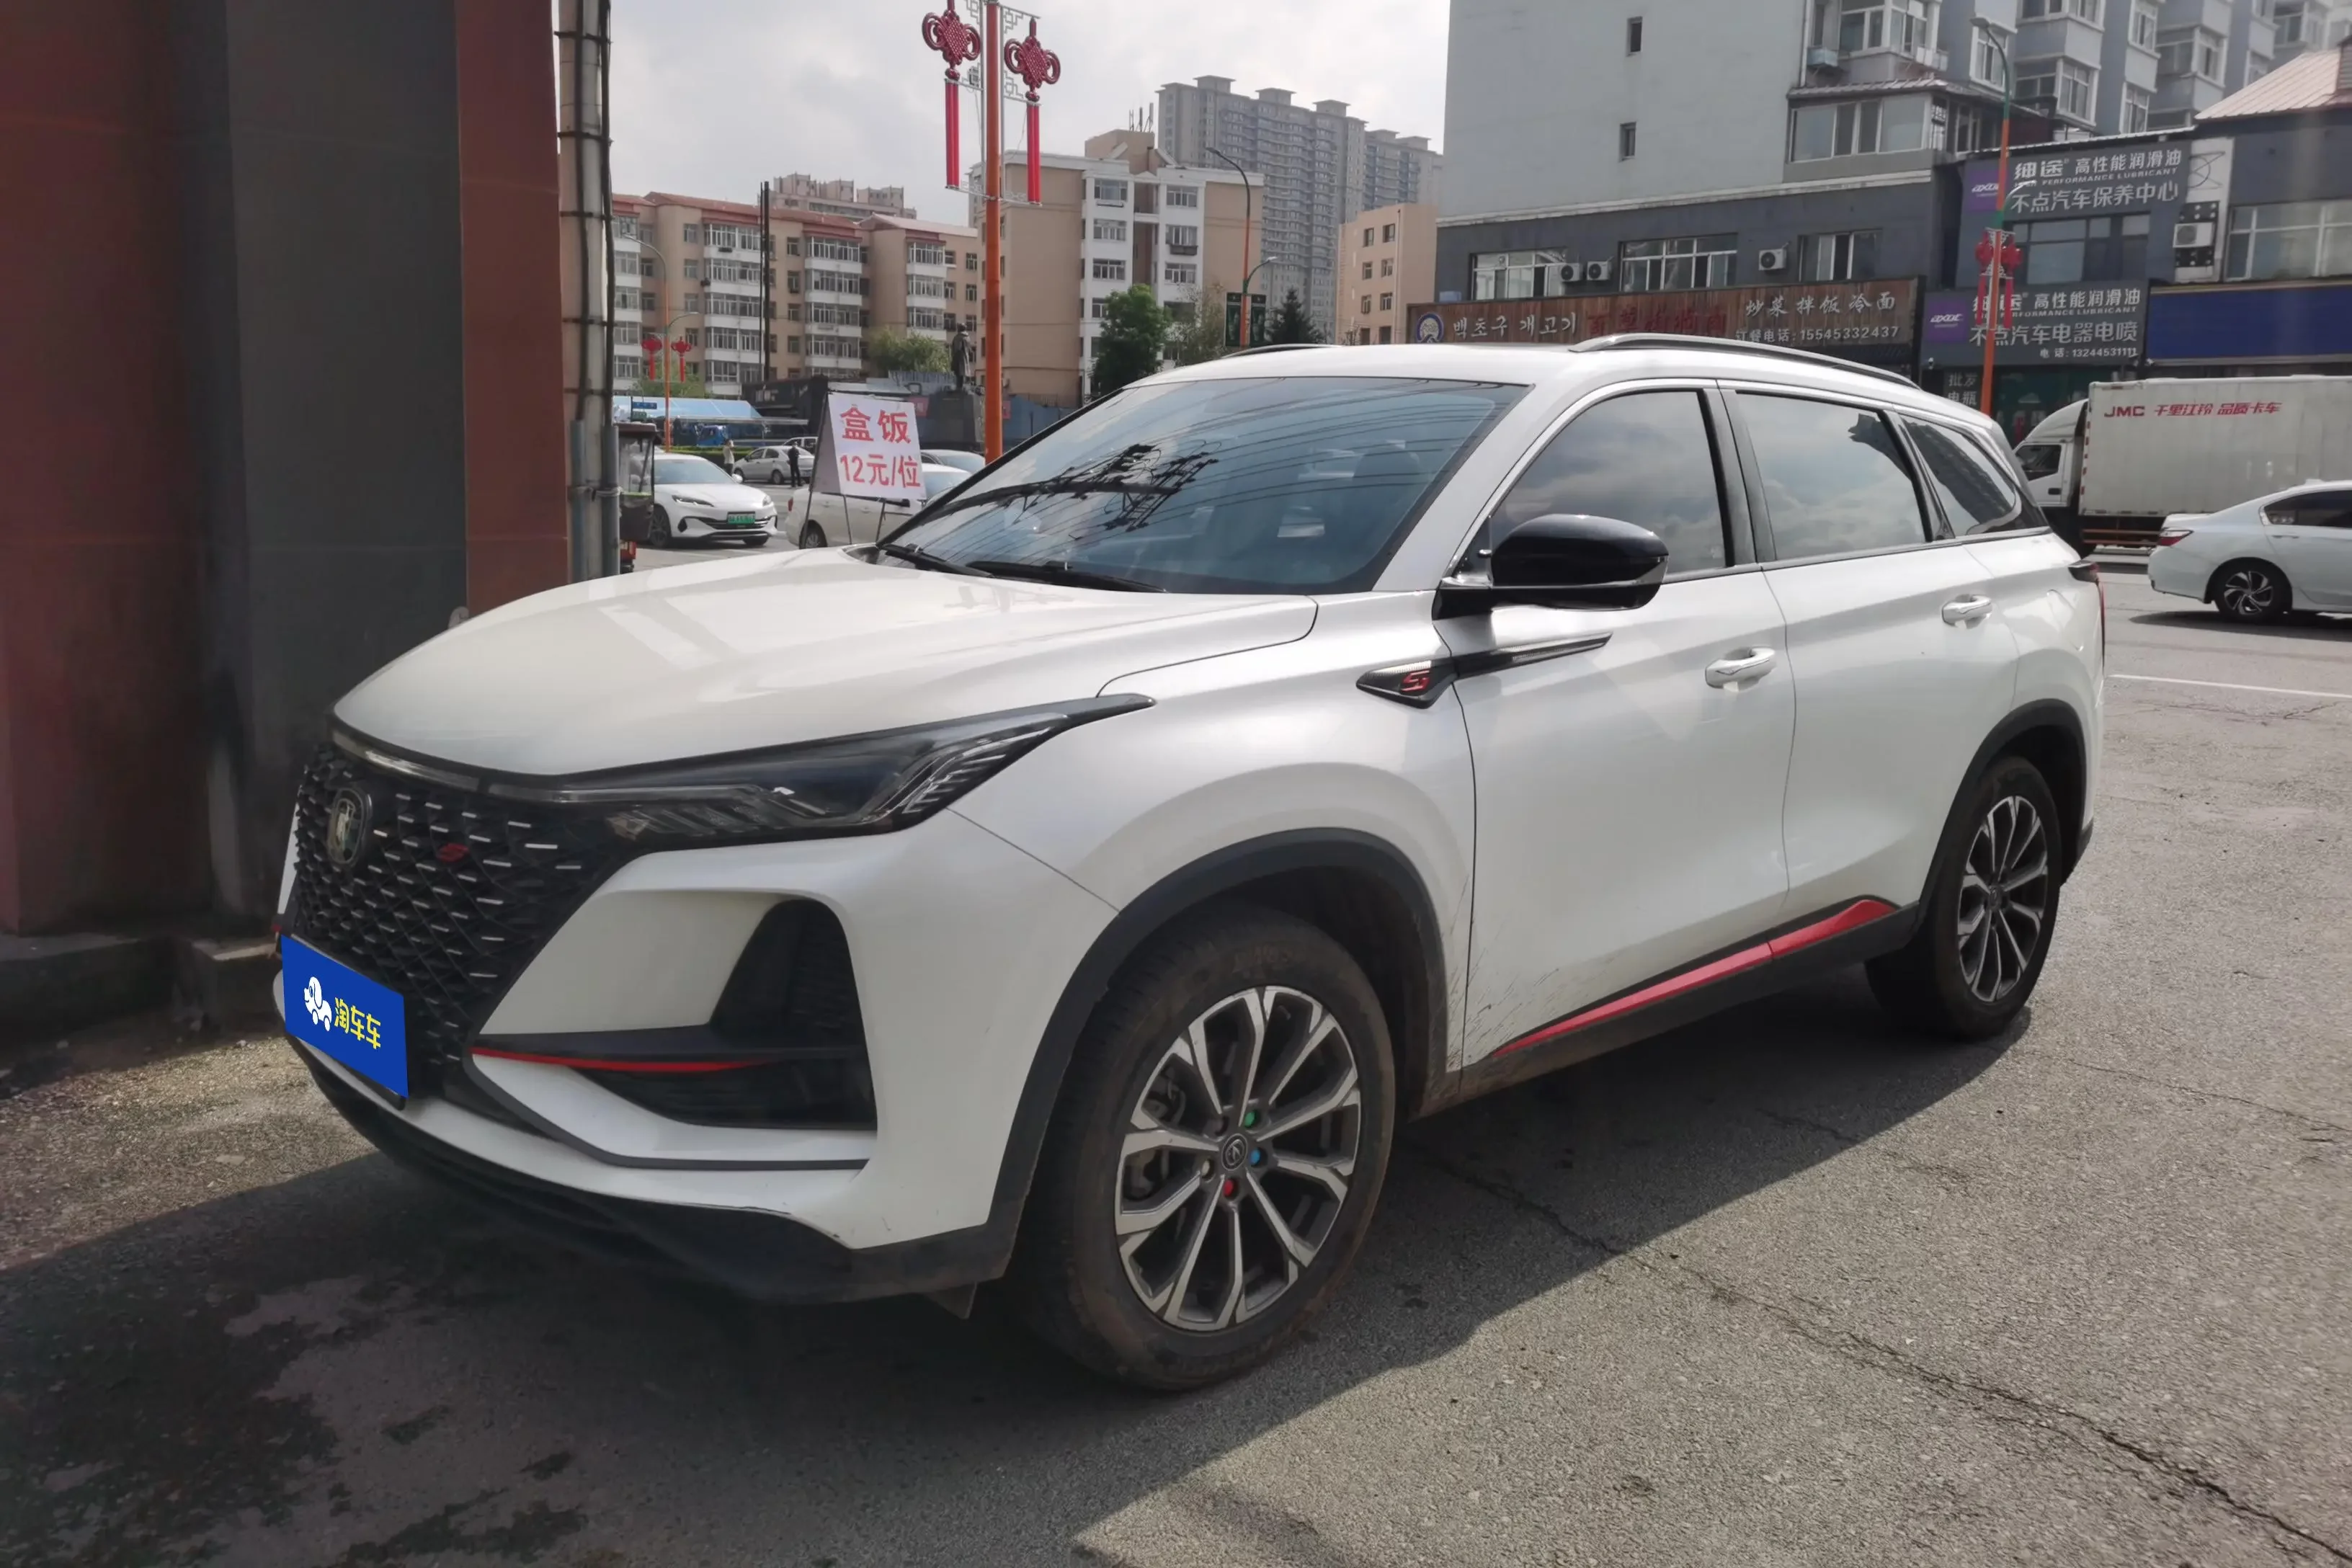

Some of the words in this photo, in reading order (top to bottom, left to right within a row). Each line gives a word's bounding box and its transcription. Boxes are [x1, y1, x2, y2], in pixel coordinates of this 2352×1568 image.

[2075, 148, 2182, 175] 高性能润滑油
[2042, 173, 2114, 186] PERFORMANCE
[2117, 166, 2178, 179] LUBRICANT
[2010, 180, 2178, 213] 不点汽车保养中心
[2034, 288, 2140, 310] 高性能润滑油
[2077, 306, 2137, 315] LUBRICANT
[1453, 315, 1507, 339] 백초구
[1519, 311, 1577, 337] 개고기
[1969, 321, 2138, 347] 不点汽车电器电喷
[2104, 406, 2145, 418] JMC
[2217, 402, 2283, 415] 品质卡车
[840, 404, 912, 444] 盒饭
[840, 453, 921, 489] 12元/位
